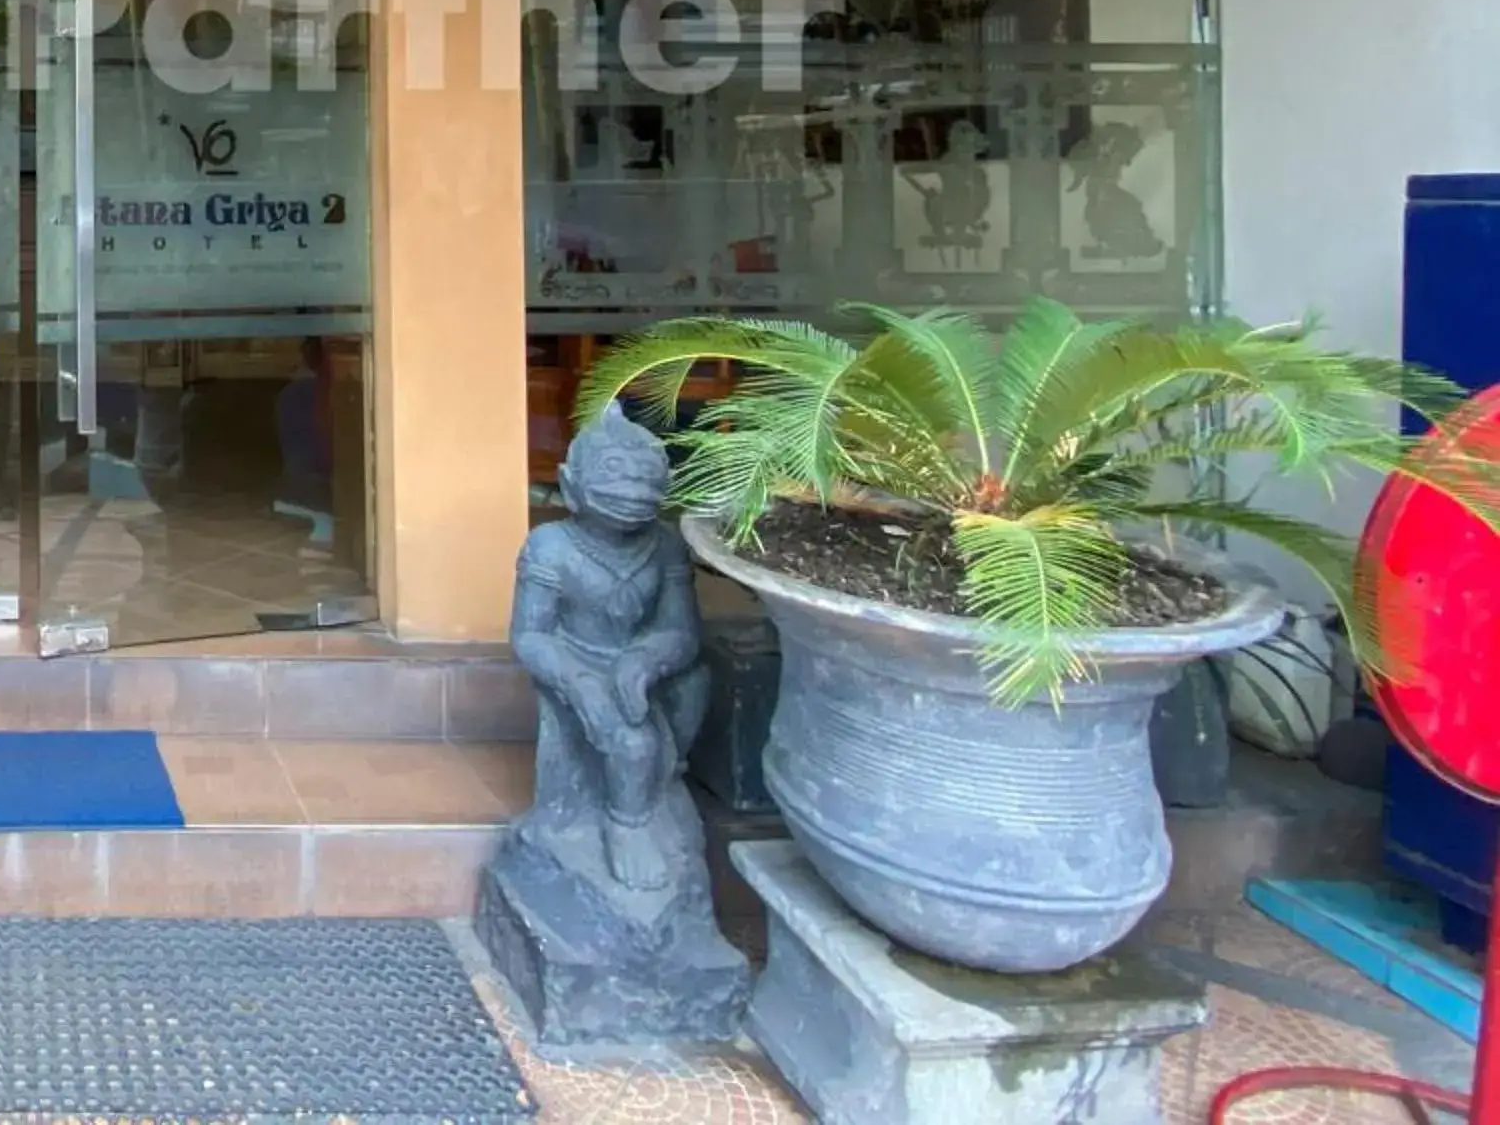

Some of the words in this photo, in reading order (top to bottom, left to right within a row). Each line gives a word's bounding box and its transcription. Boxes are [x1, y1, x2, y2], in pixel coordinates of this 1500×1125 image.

[55, 195, 192, 225] Itana
[205, 192, 310, 232] Griya
[321, 193, 346, 224] 2
[101, 234, 308, 252] HOTEL
